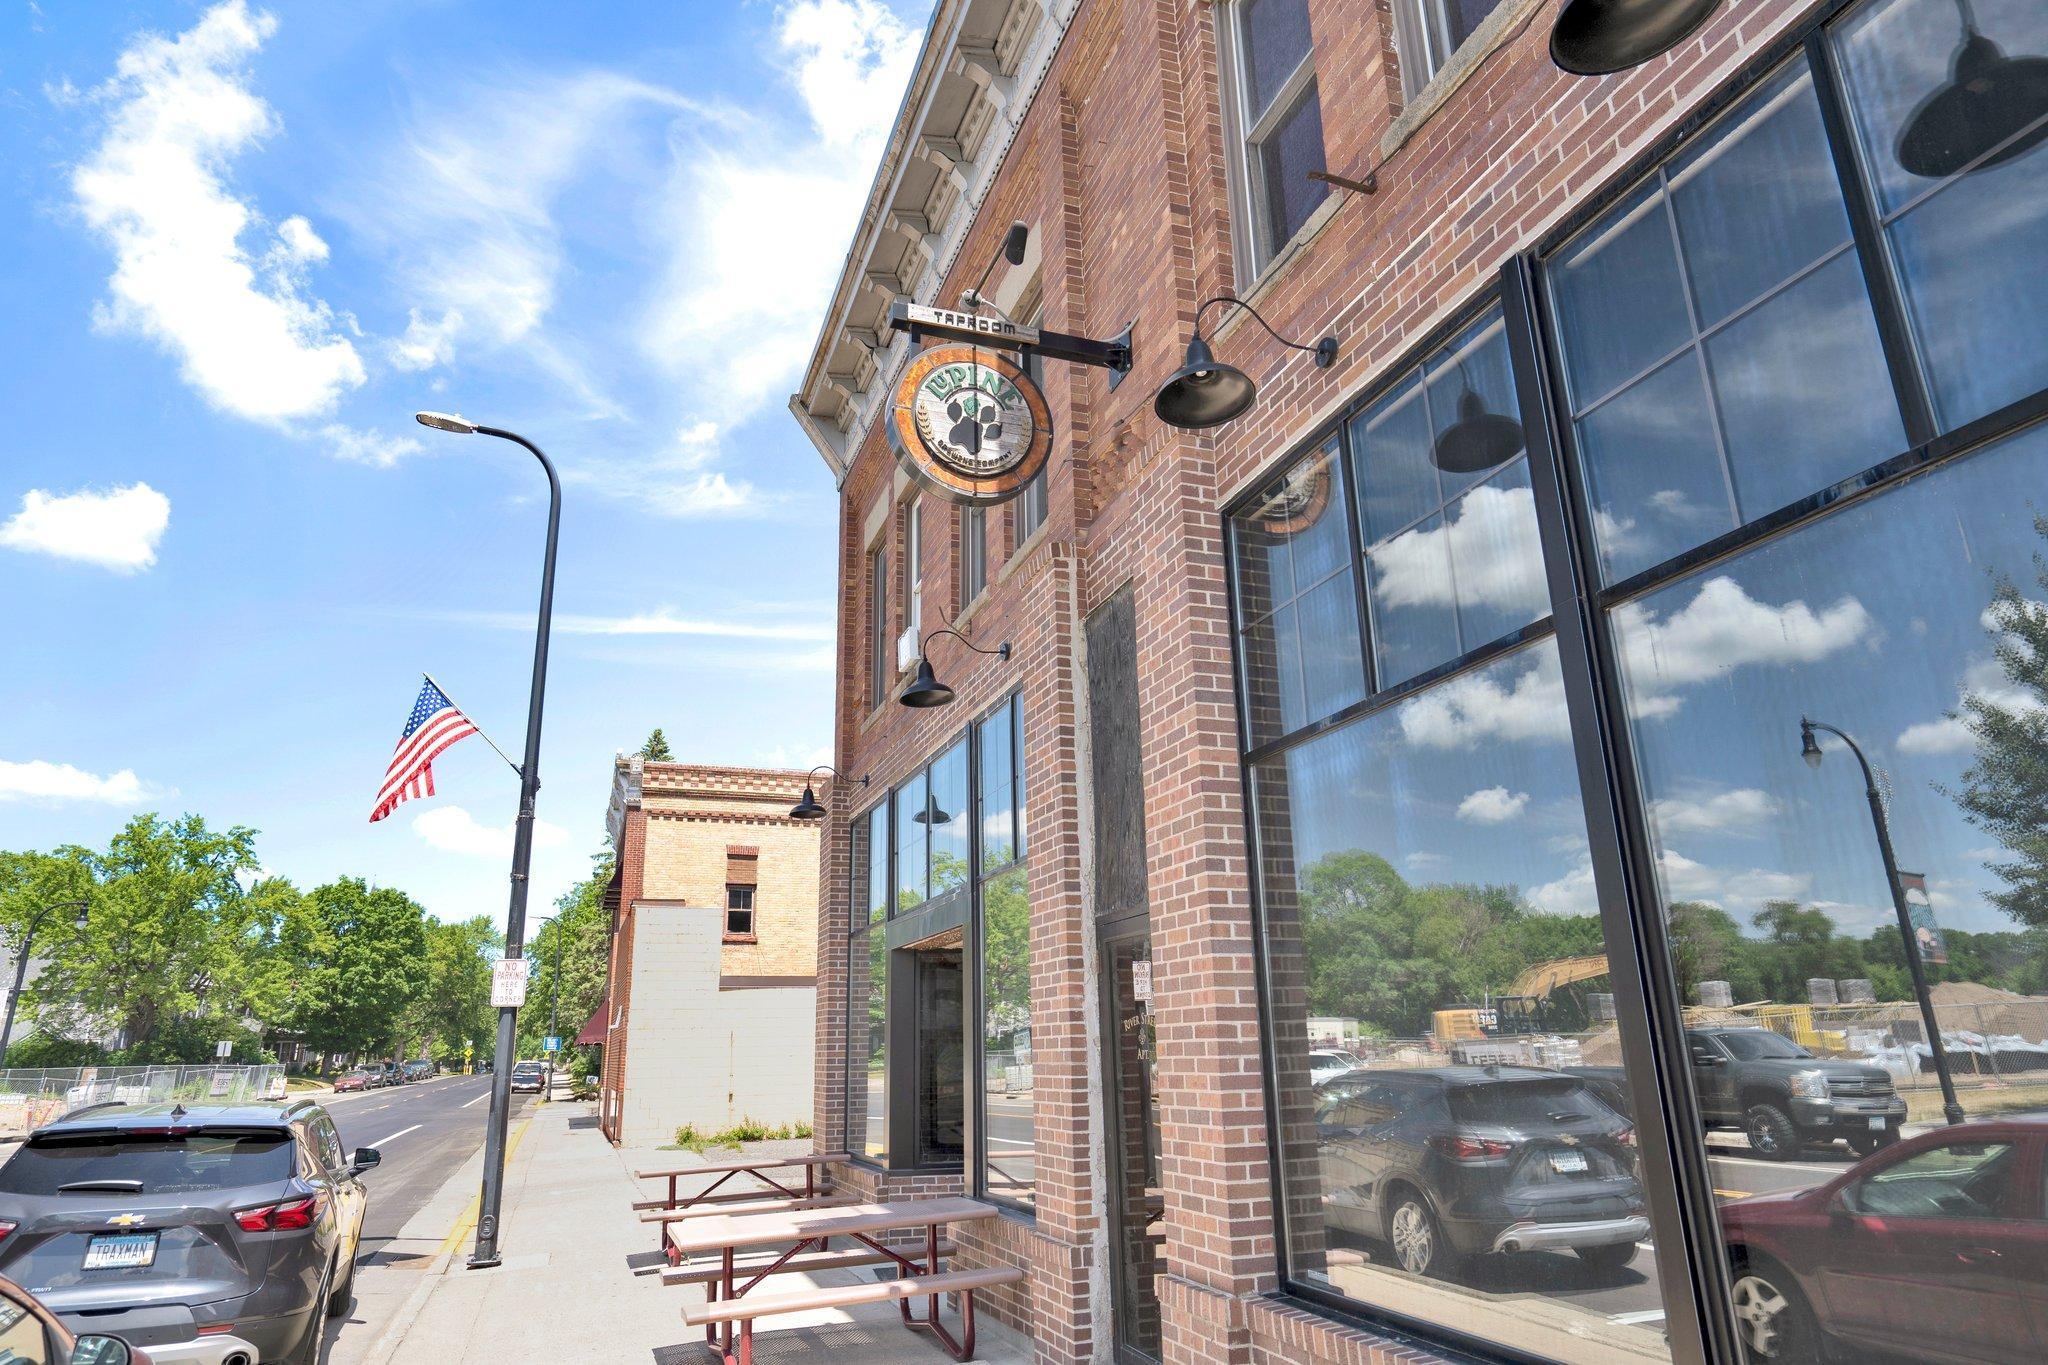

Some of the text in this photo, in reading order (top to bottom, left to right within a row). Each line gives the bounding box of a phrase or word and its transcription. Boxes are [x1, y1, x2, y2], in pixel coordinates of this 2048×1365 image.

[934, 311, 1016, 335] TAPROOM
[925, 365, 1023, 410] LUPINE
[937, 440, 1012, 467] BREWING COMPANY
[505, 962, 517, 971] NO
[497, 971, 524, 980] PARKING
[1123, 1015, 1140, 1032] RIVER
[96, 1243, 149, 1260] TRAXMAN
